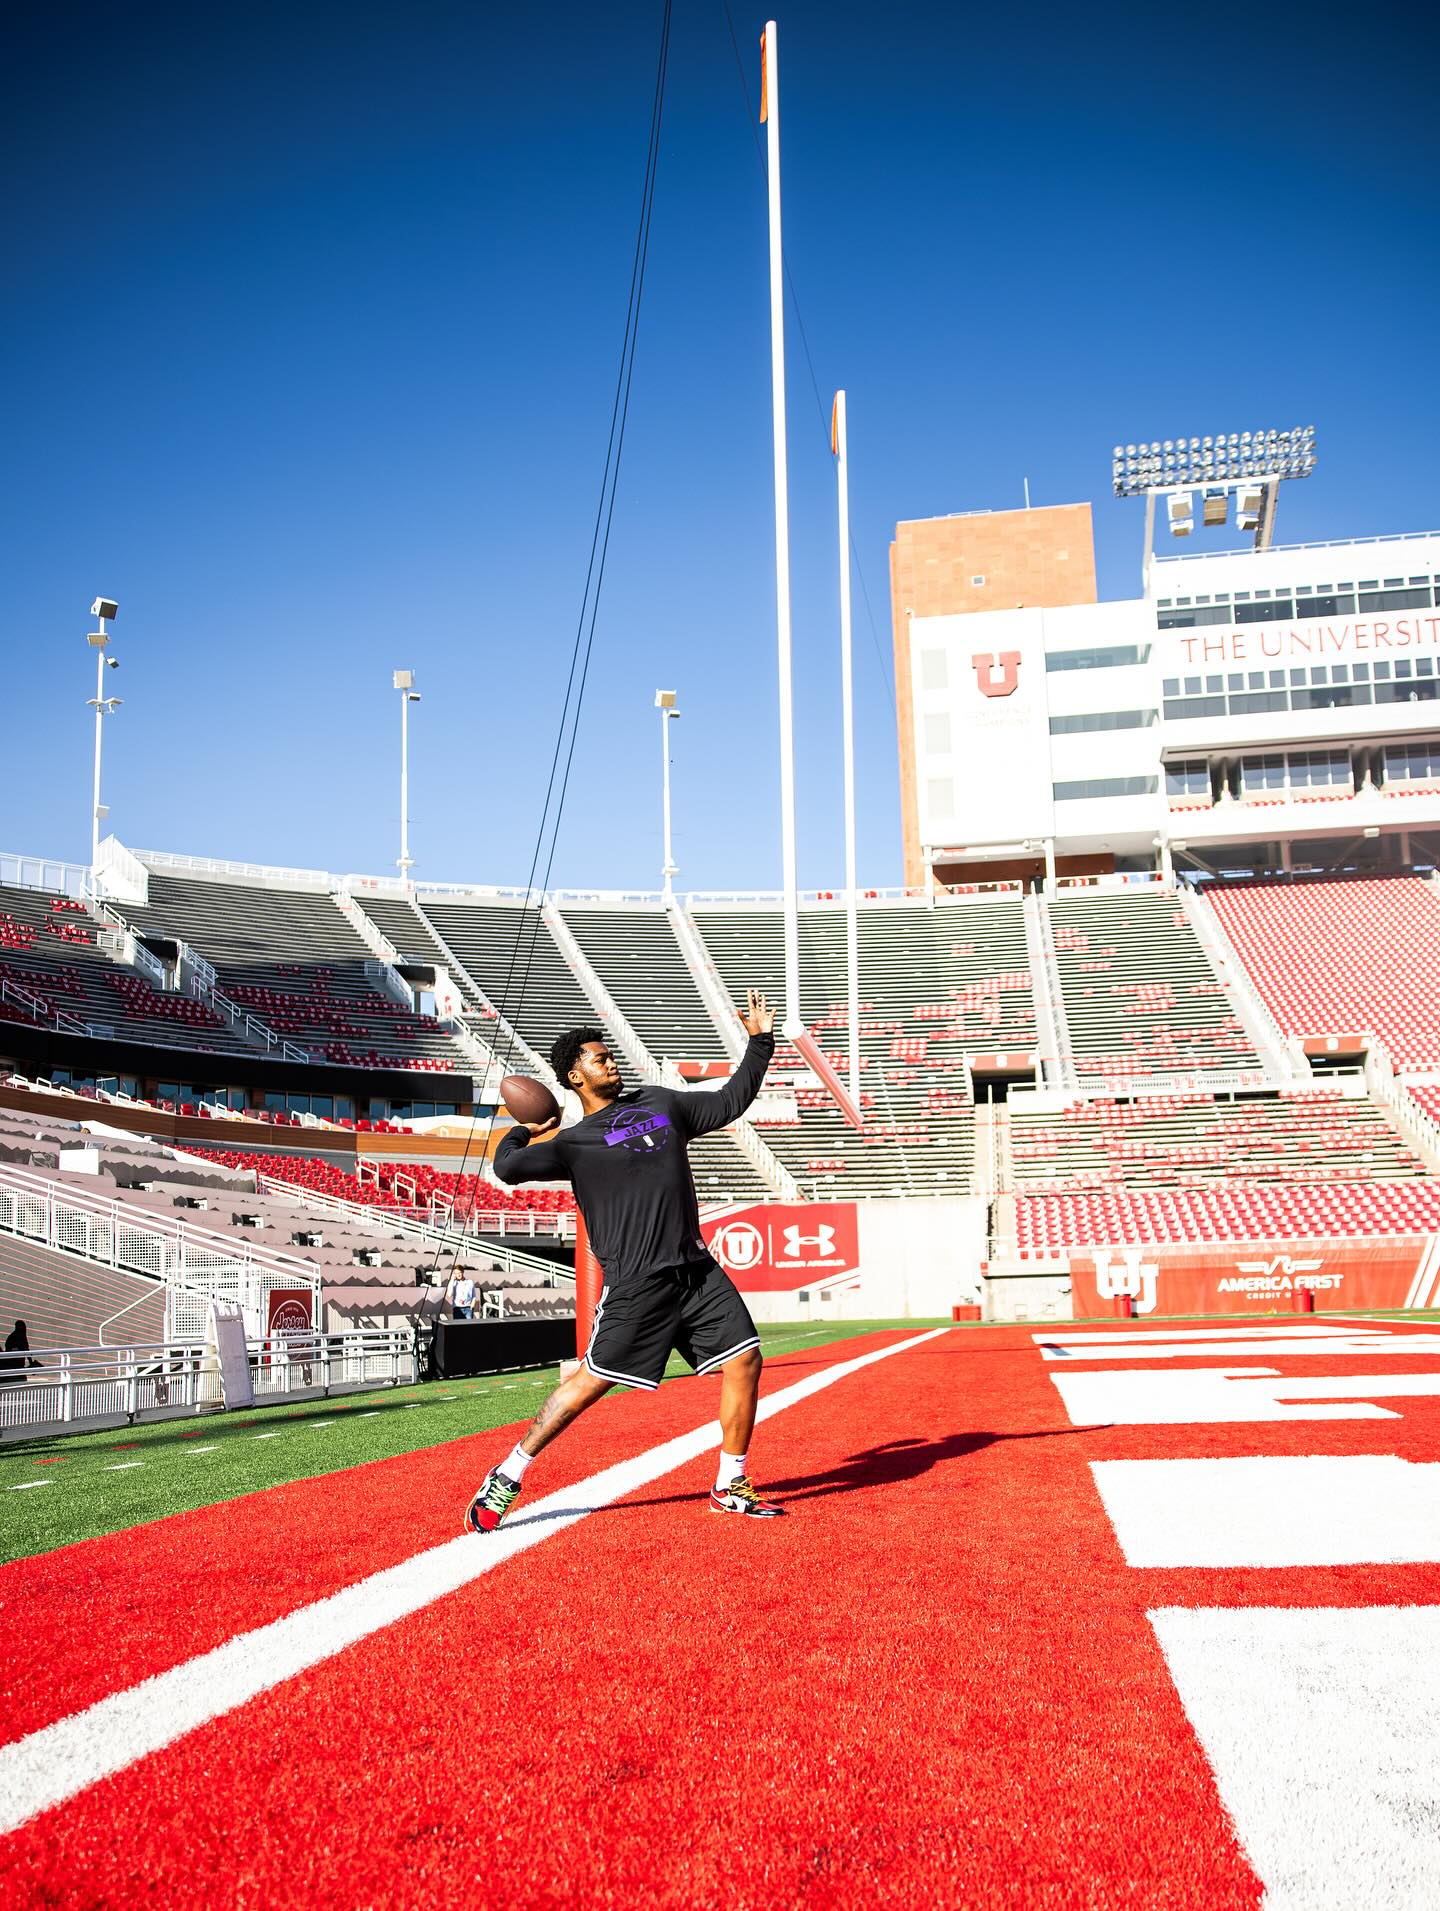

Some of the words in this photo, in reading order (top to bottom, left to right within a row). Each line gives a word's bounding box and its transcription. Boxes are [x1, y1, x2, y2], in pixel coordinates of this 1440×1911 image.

[1181, 635, 1246, 662] THE
[1261, 618, 1440, 657] UNIVERSIT
[971, 651, 1021, 697] U
[624, 1120, 658, 1138] JAZZ
[725, 1231, 755, 1264] U
[1217, 1276, 1293, 1292] AMERICA
[1294, 1274, 1344, 1289] FIRST
[1246, 1291, 1281, 1300] CREDIT
